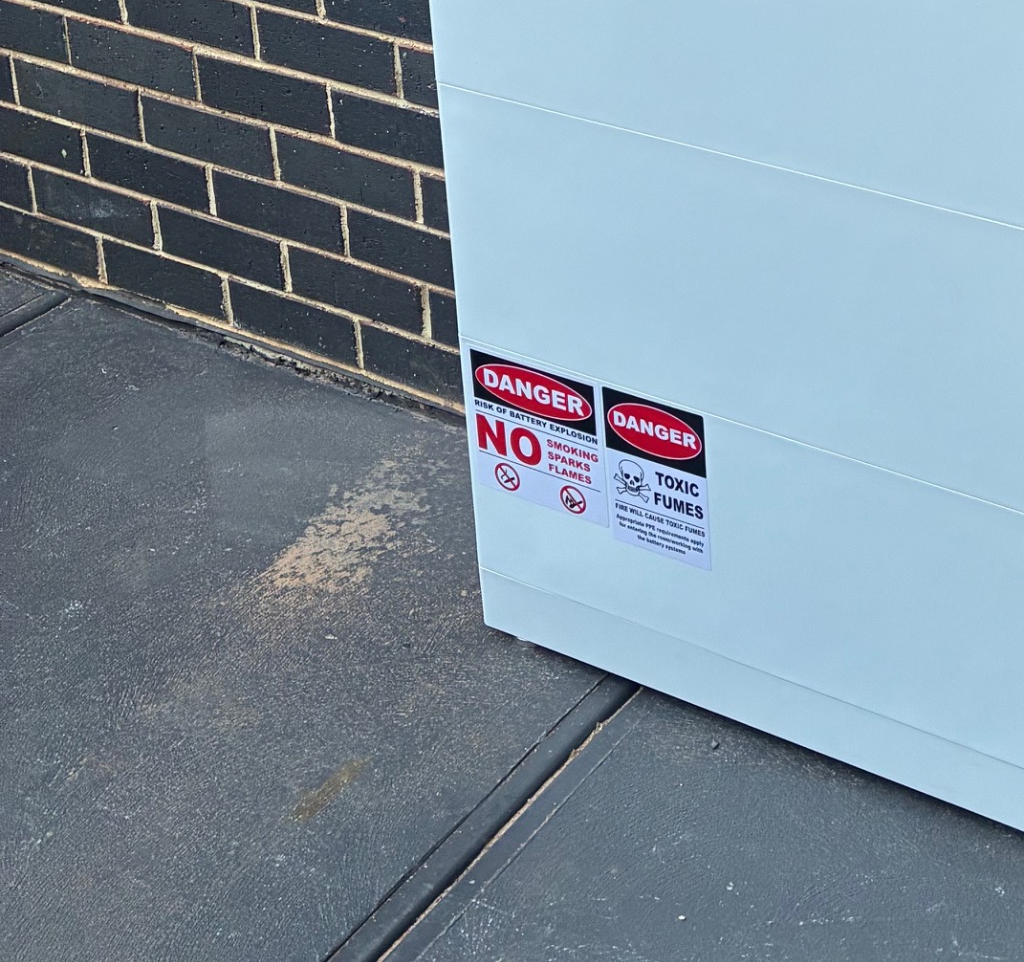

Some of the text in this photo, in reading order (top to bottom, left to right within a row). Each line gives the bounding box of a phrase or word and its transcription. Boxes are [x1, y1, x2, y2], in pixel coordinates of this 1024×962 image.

[483, 368, 585, 417] DANGER
[474, 399, 598, 446] RISK OF BATTERY EXPLOSION
[613, 410, 697, 450] DANGER
[476, 413, 542, 466] NO
[546, 439, 599, 463] SMOKING
[548, 452, 591, 472] SPARKS
[548, 464, 592, 485] FLAMES
[655, 472, 700, 498] TOXIC
[615, 502, 706, 538] FIRE WILL CAUSE TOXIC FUMES
[654, 492, 704, 520] FUMES
[616, 513, 704, 548] Appropriate PPE requirements apply
[627, 525, 648, 536] entering
[648, 530, 656, 538] the
[692, 546, 704, 554] with
[646, 537, 664, 548] battery
[665, 544, 686, 555] systems
